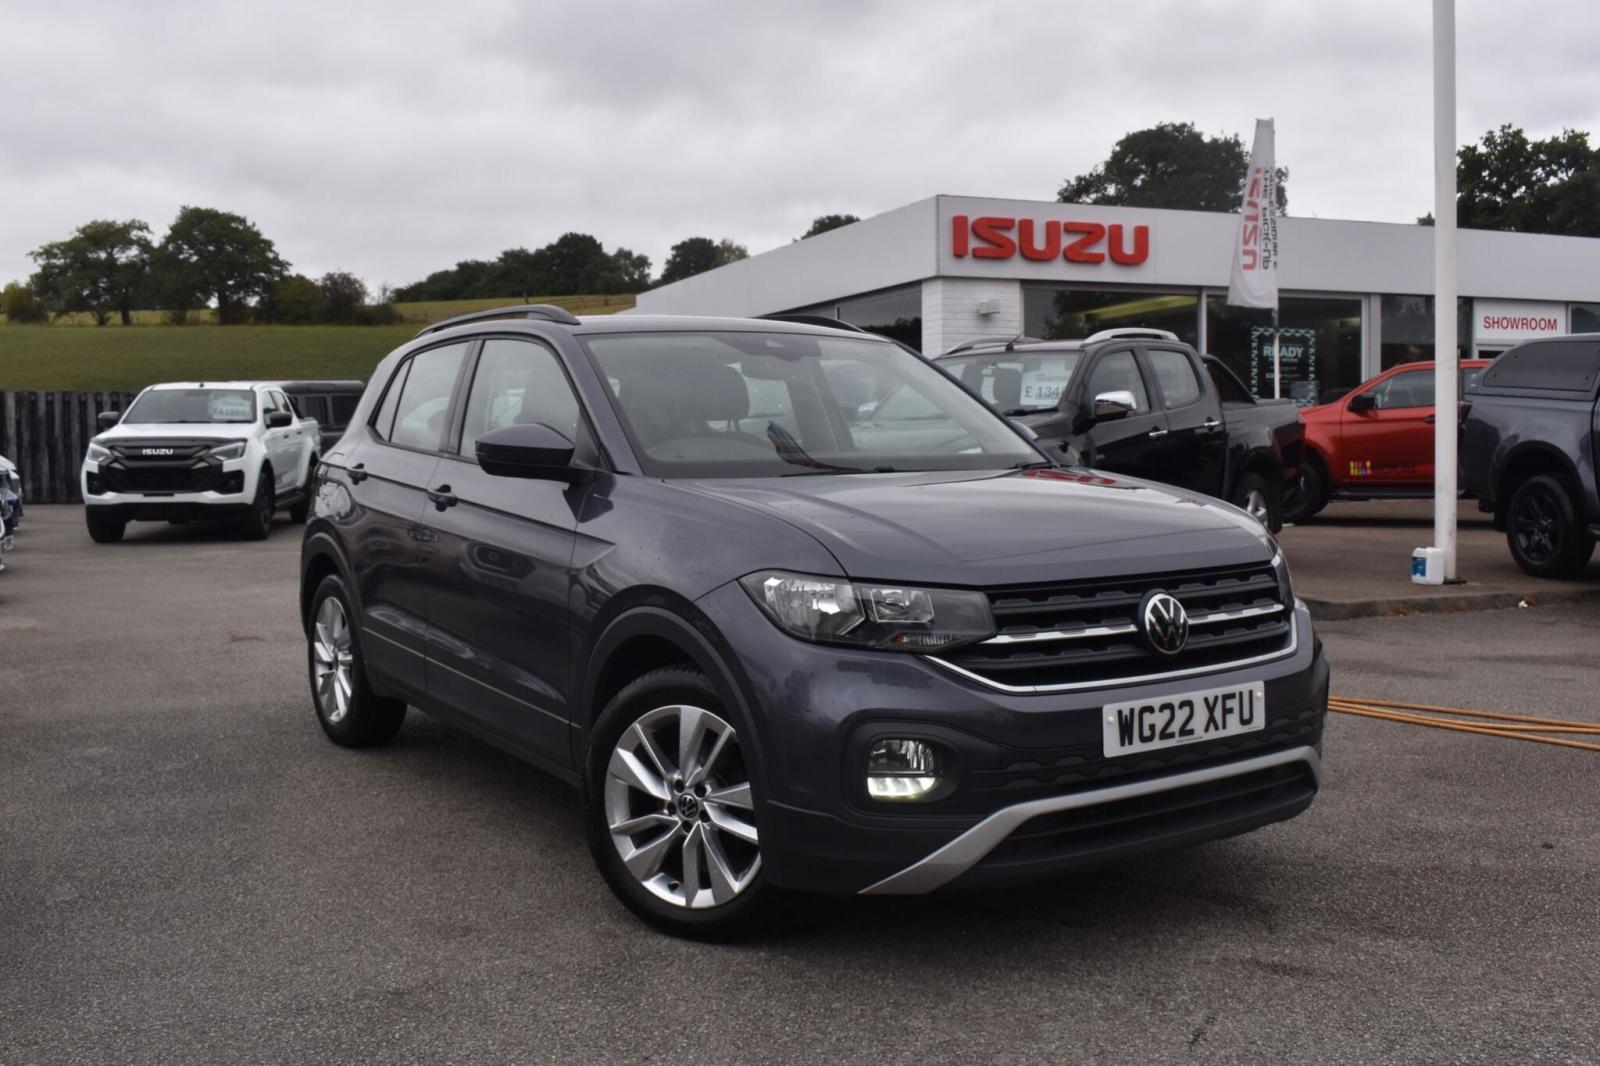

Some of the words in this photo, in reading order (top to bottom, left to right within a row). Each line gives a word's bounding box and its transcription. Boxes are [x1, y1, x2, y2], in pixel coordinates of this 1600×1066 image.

[952, 214, 1149, 266] ISUZU
[1483, 316, 1558, 331] SHOWROOM
[1117, 699, 1195, 747] WG22
[1203, 689, 1253, 733] XFU
